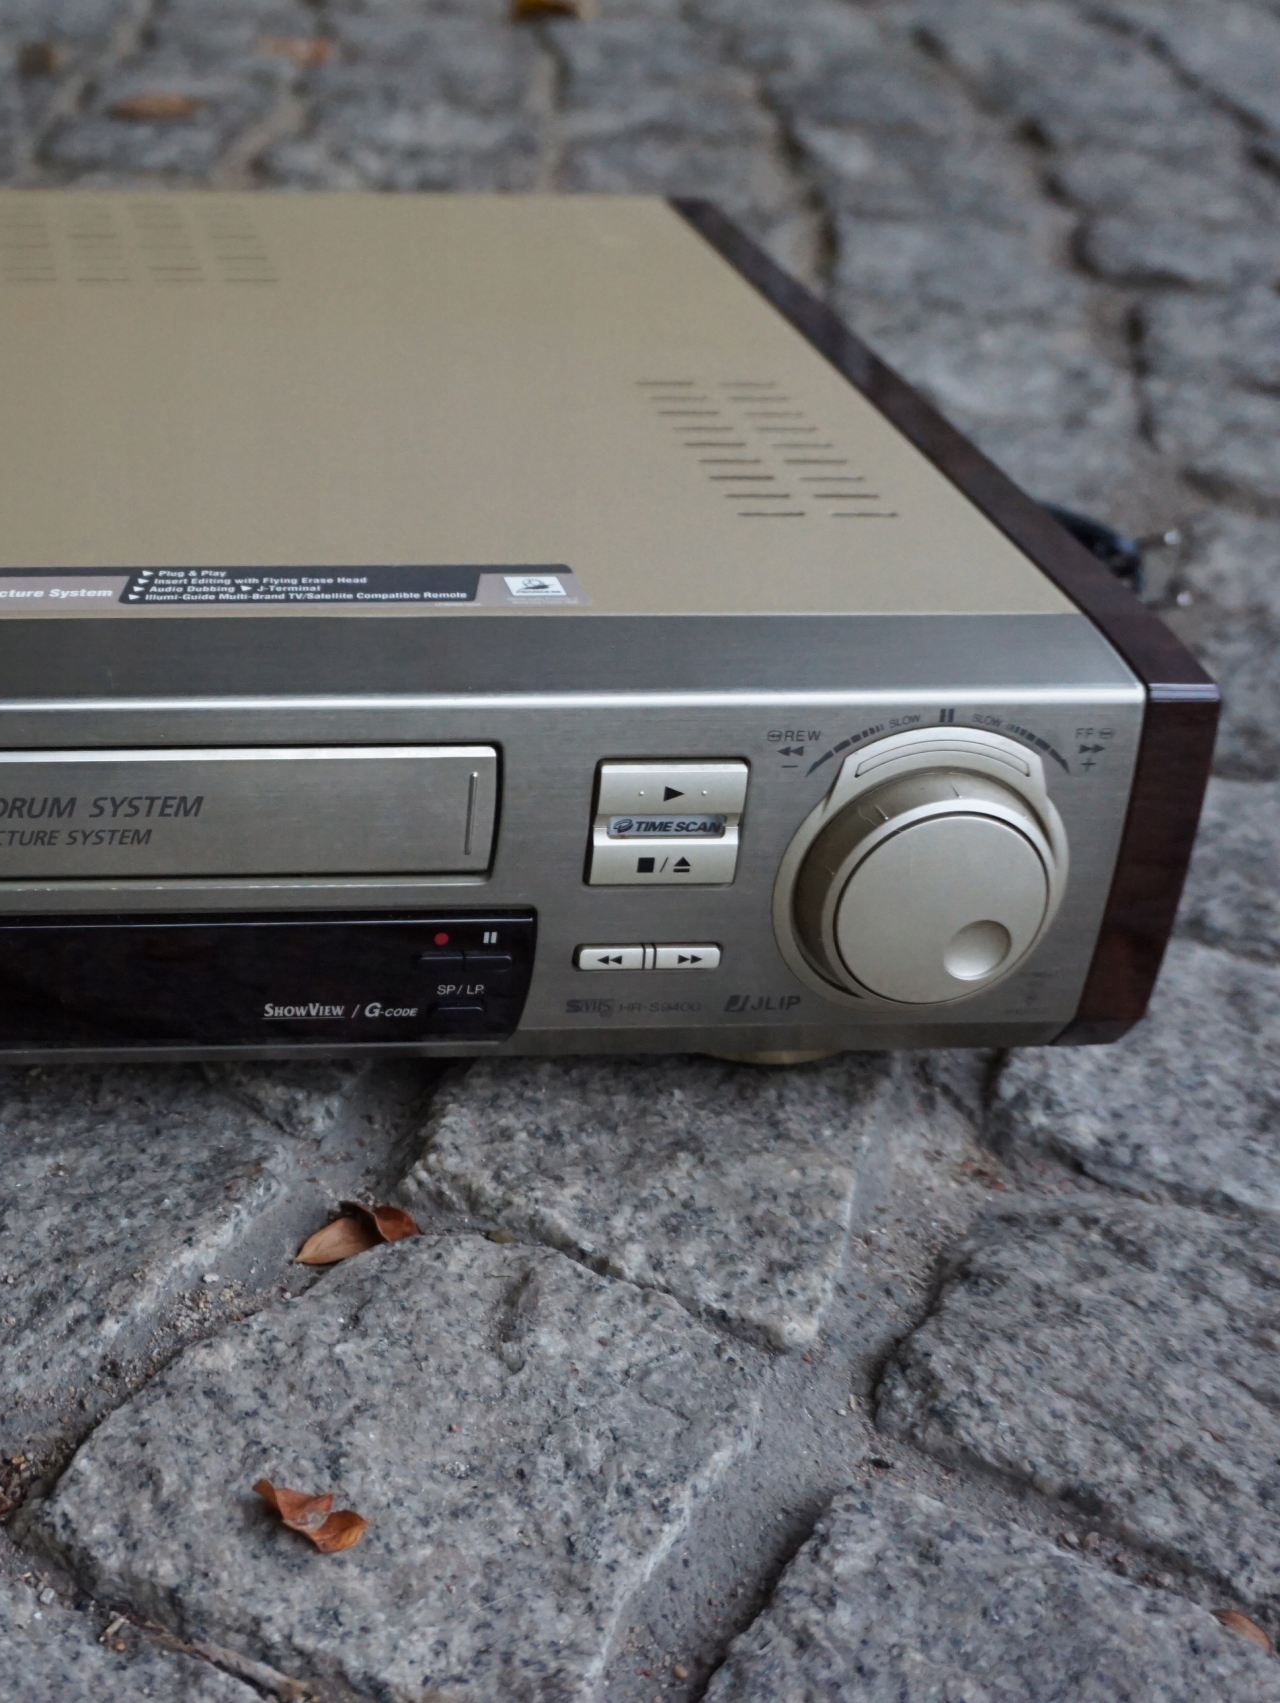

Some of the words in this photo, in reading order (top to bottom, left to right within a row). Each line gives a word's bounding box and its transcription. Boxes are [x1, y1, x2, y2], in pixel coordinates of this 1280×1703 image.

[158, 570, 185, 578] Plug
[201, 570, 227, 578] Play
[262, 577, 298, 585] Flying
[49, 588, 113, 599] System
[356, 592, 420, 600] Compatible
[889, 714, 921, 729] SLOW
[784, 730, 821, 742] REW
[89, 796, 204, 818] SYSTEM
[635, 821, 674, 832] TIME
[675, 821, 724, 832] SCAN
[65, 829, 152, 846] SYSTEM
